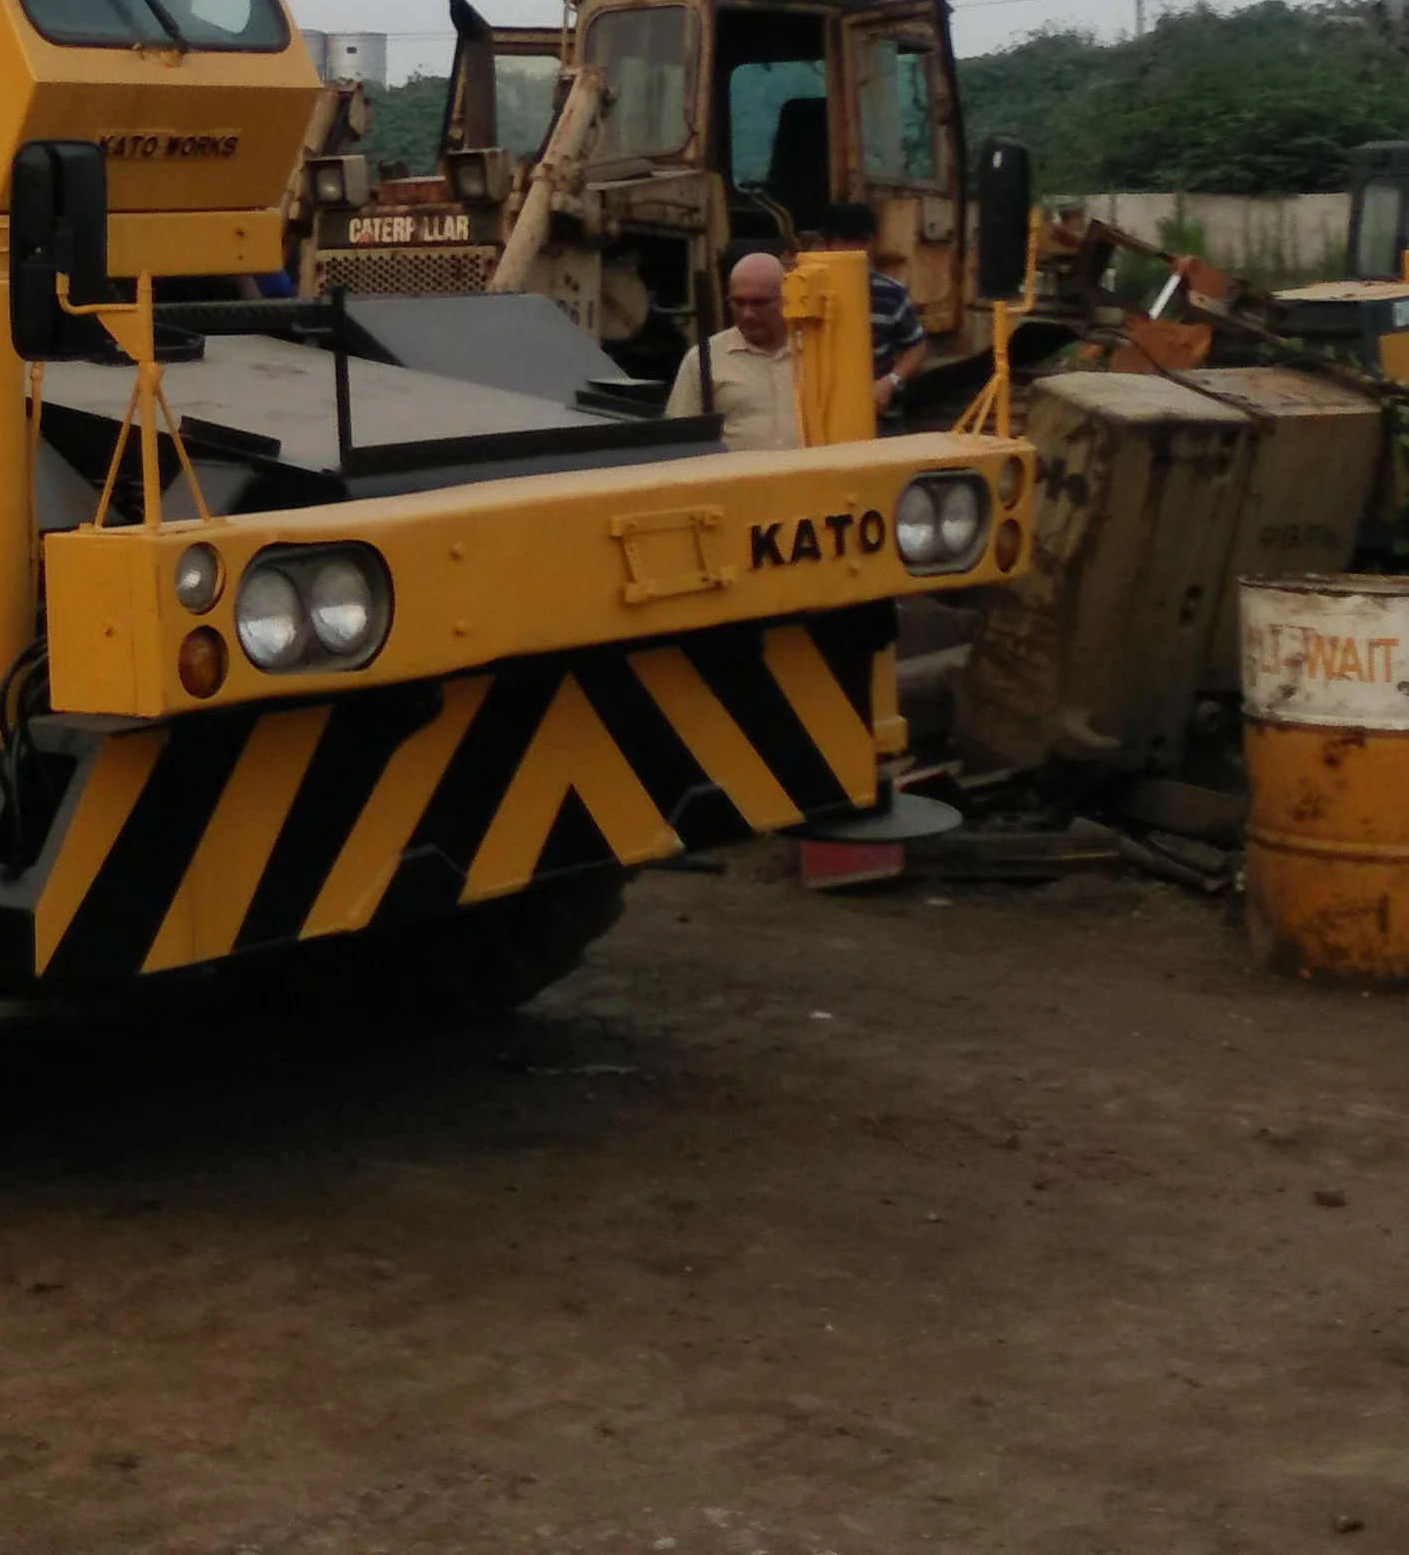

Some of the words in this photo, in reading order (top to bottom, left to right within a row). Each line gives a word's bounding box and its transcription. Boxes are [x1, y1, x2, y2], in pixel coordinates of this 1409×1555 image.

[99, 134, 159, 157] KATO
[165, 134, 239, 157] WORKS
[349, 214, 470, 243] CATERPLLAR
[750, 509, 886, 571] KATO
